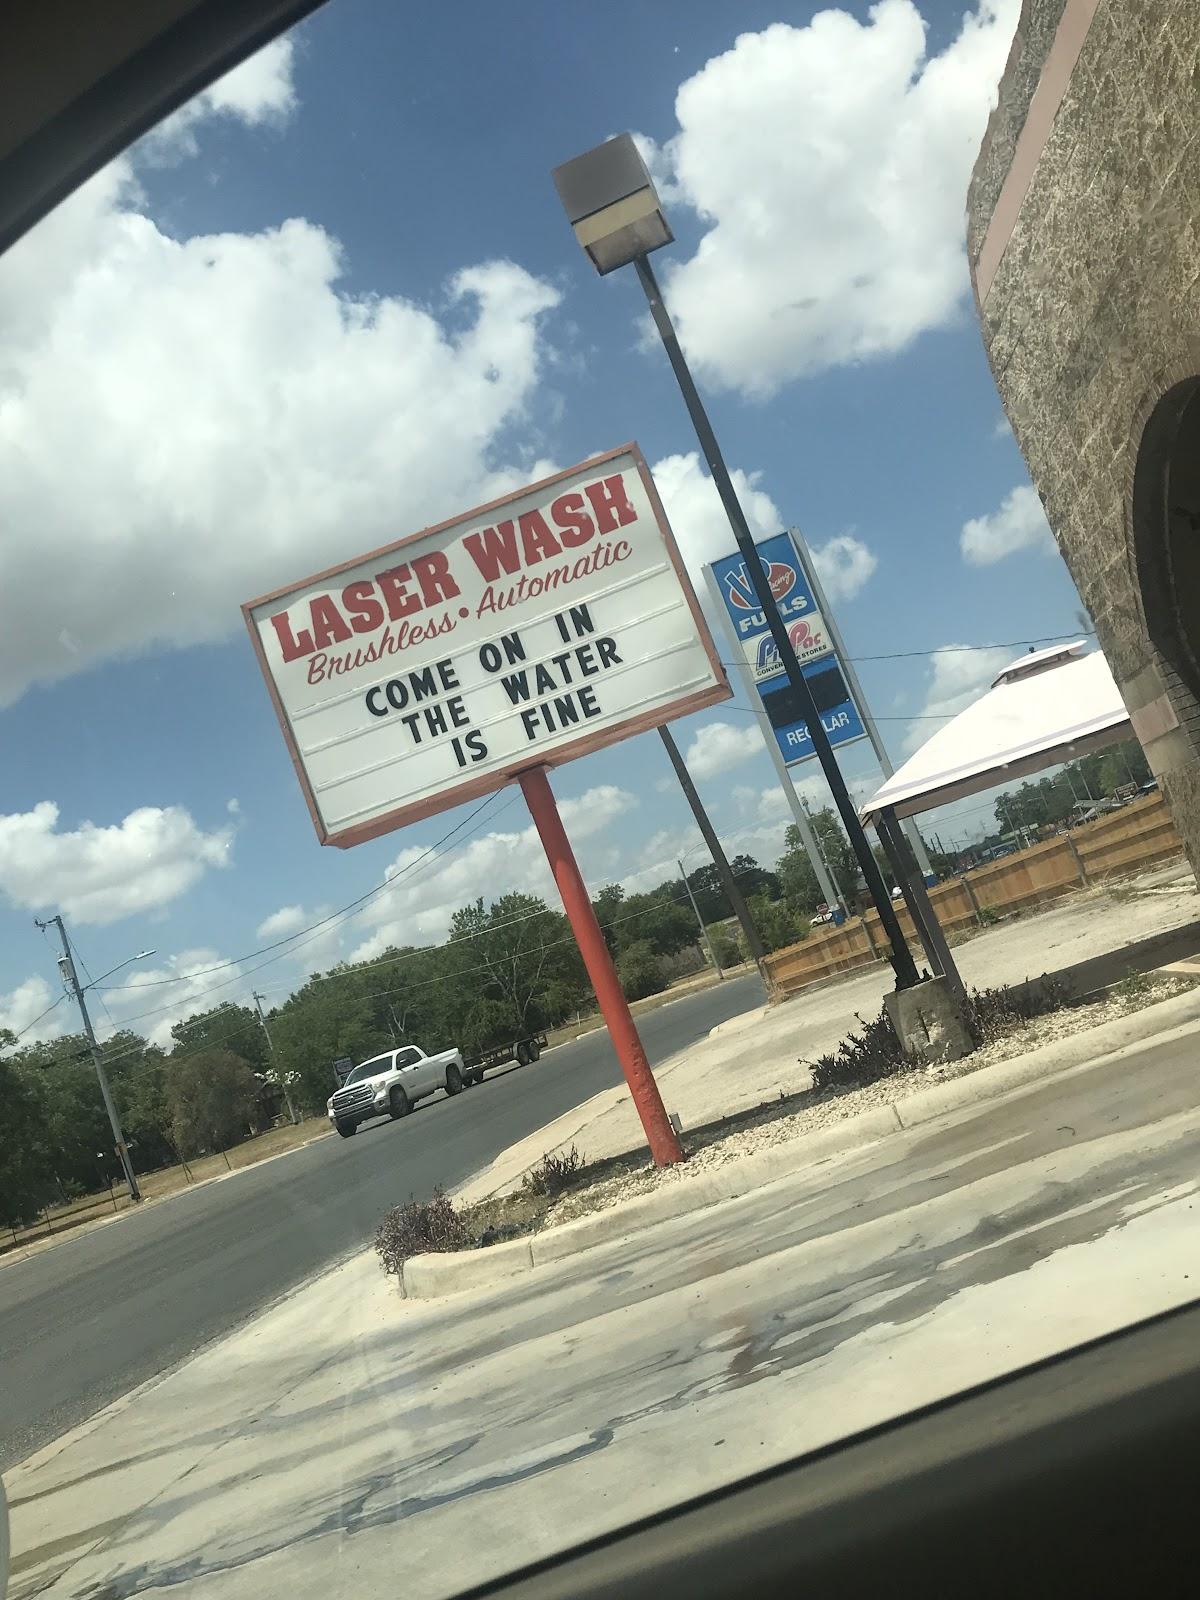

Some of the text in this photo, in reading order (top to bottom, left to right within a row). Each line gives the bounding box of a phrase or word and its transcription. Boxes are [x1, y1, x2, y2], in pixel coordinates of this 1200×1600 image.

[270, 474, 638, 663] LASER WASH
[307, 539, 633, 685] Brushless Automatic
[739, 595, 808, 633] FULS
[365, 602, 595, 717] COME ON IN
[402, 636, 624, 744] THE WATER
[801, 643, 828, 659] STORES
[450, 685, 601, 768] IS FINE
[786, 711, 850, 746] RELAR
